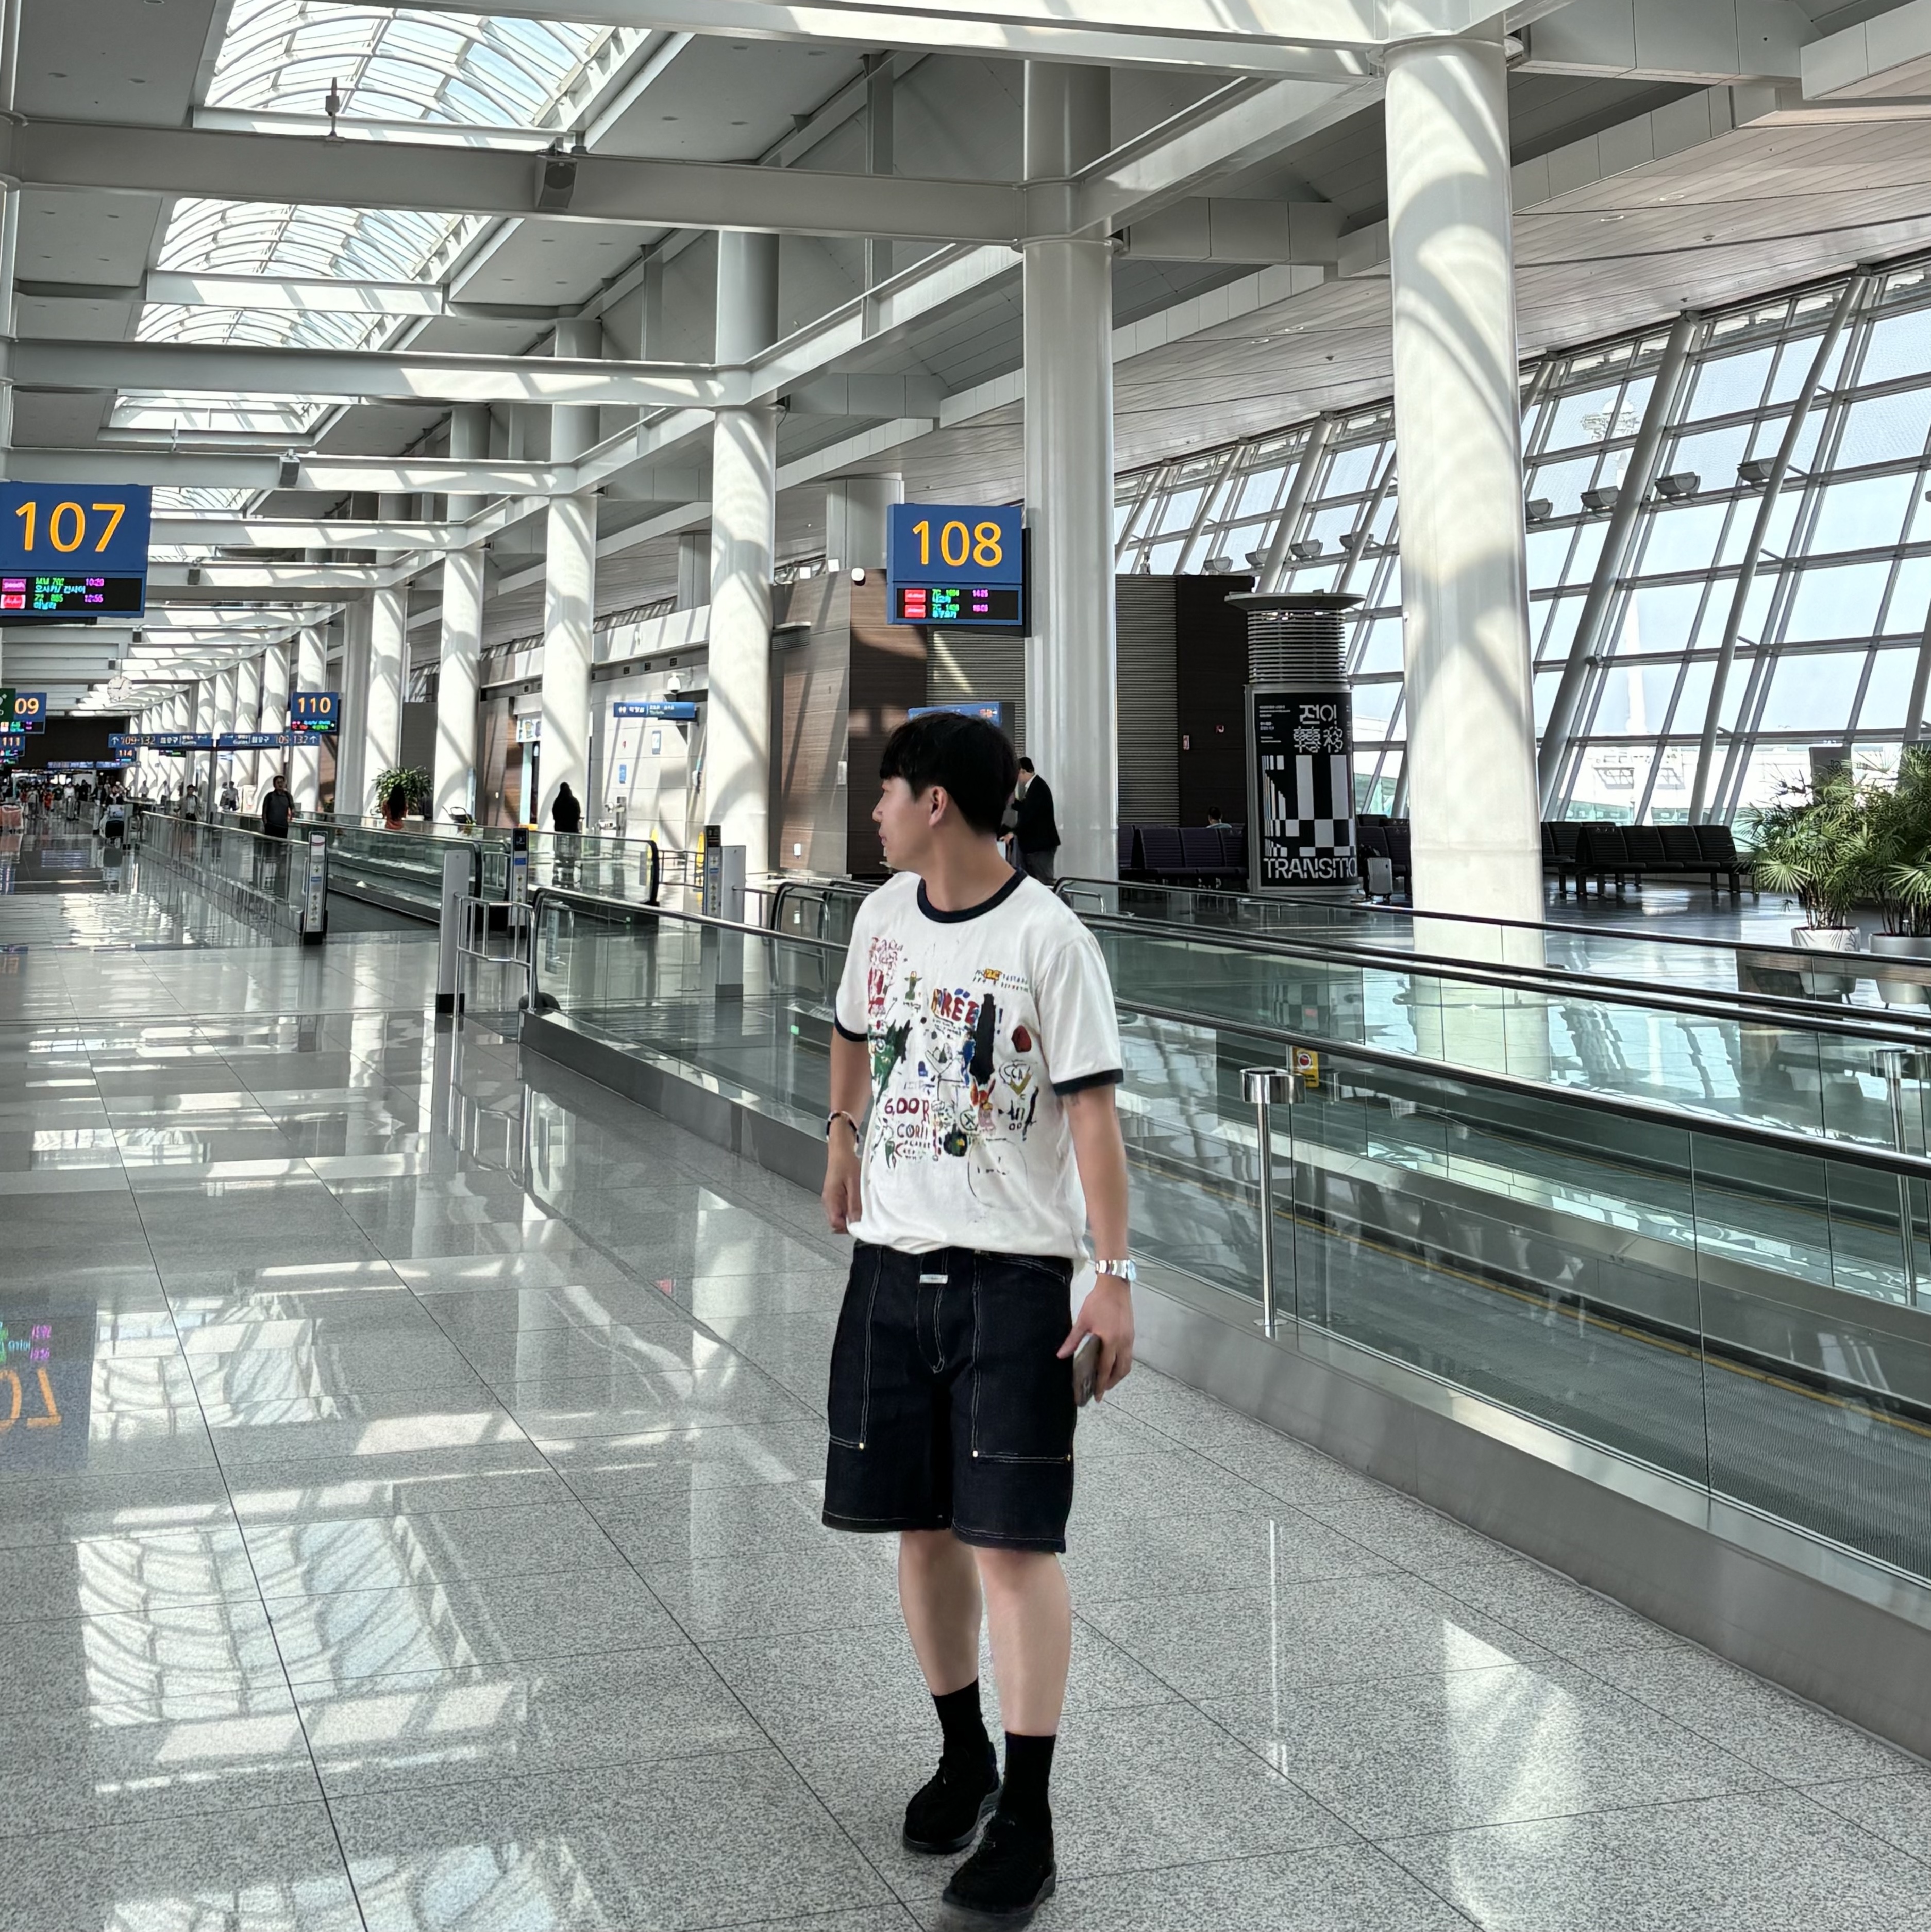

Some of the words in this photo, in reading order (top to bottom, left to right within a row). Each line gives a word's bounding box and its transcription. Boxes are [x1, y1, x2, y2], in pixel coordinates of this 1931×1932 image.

[15, 502, 125, 552] 107
[912, 521, 1002, 567] 108
[15, 698, 39, 714] 09
[298, 697, 331, 713] 110
[3, 737, 20, 746] 111
